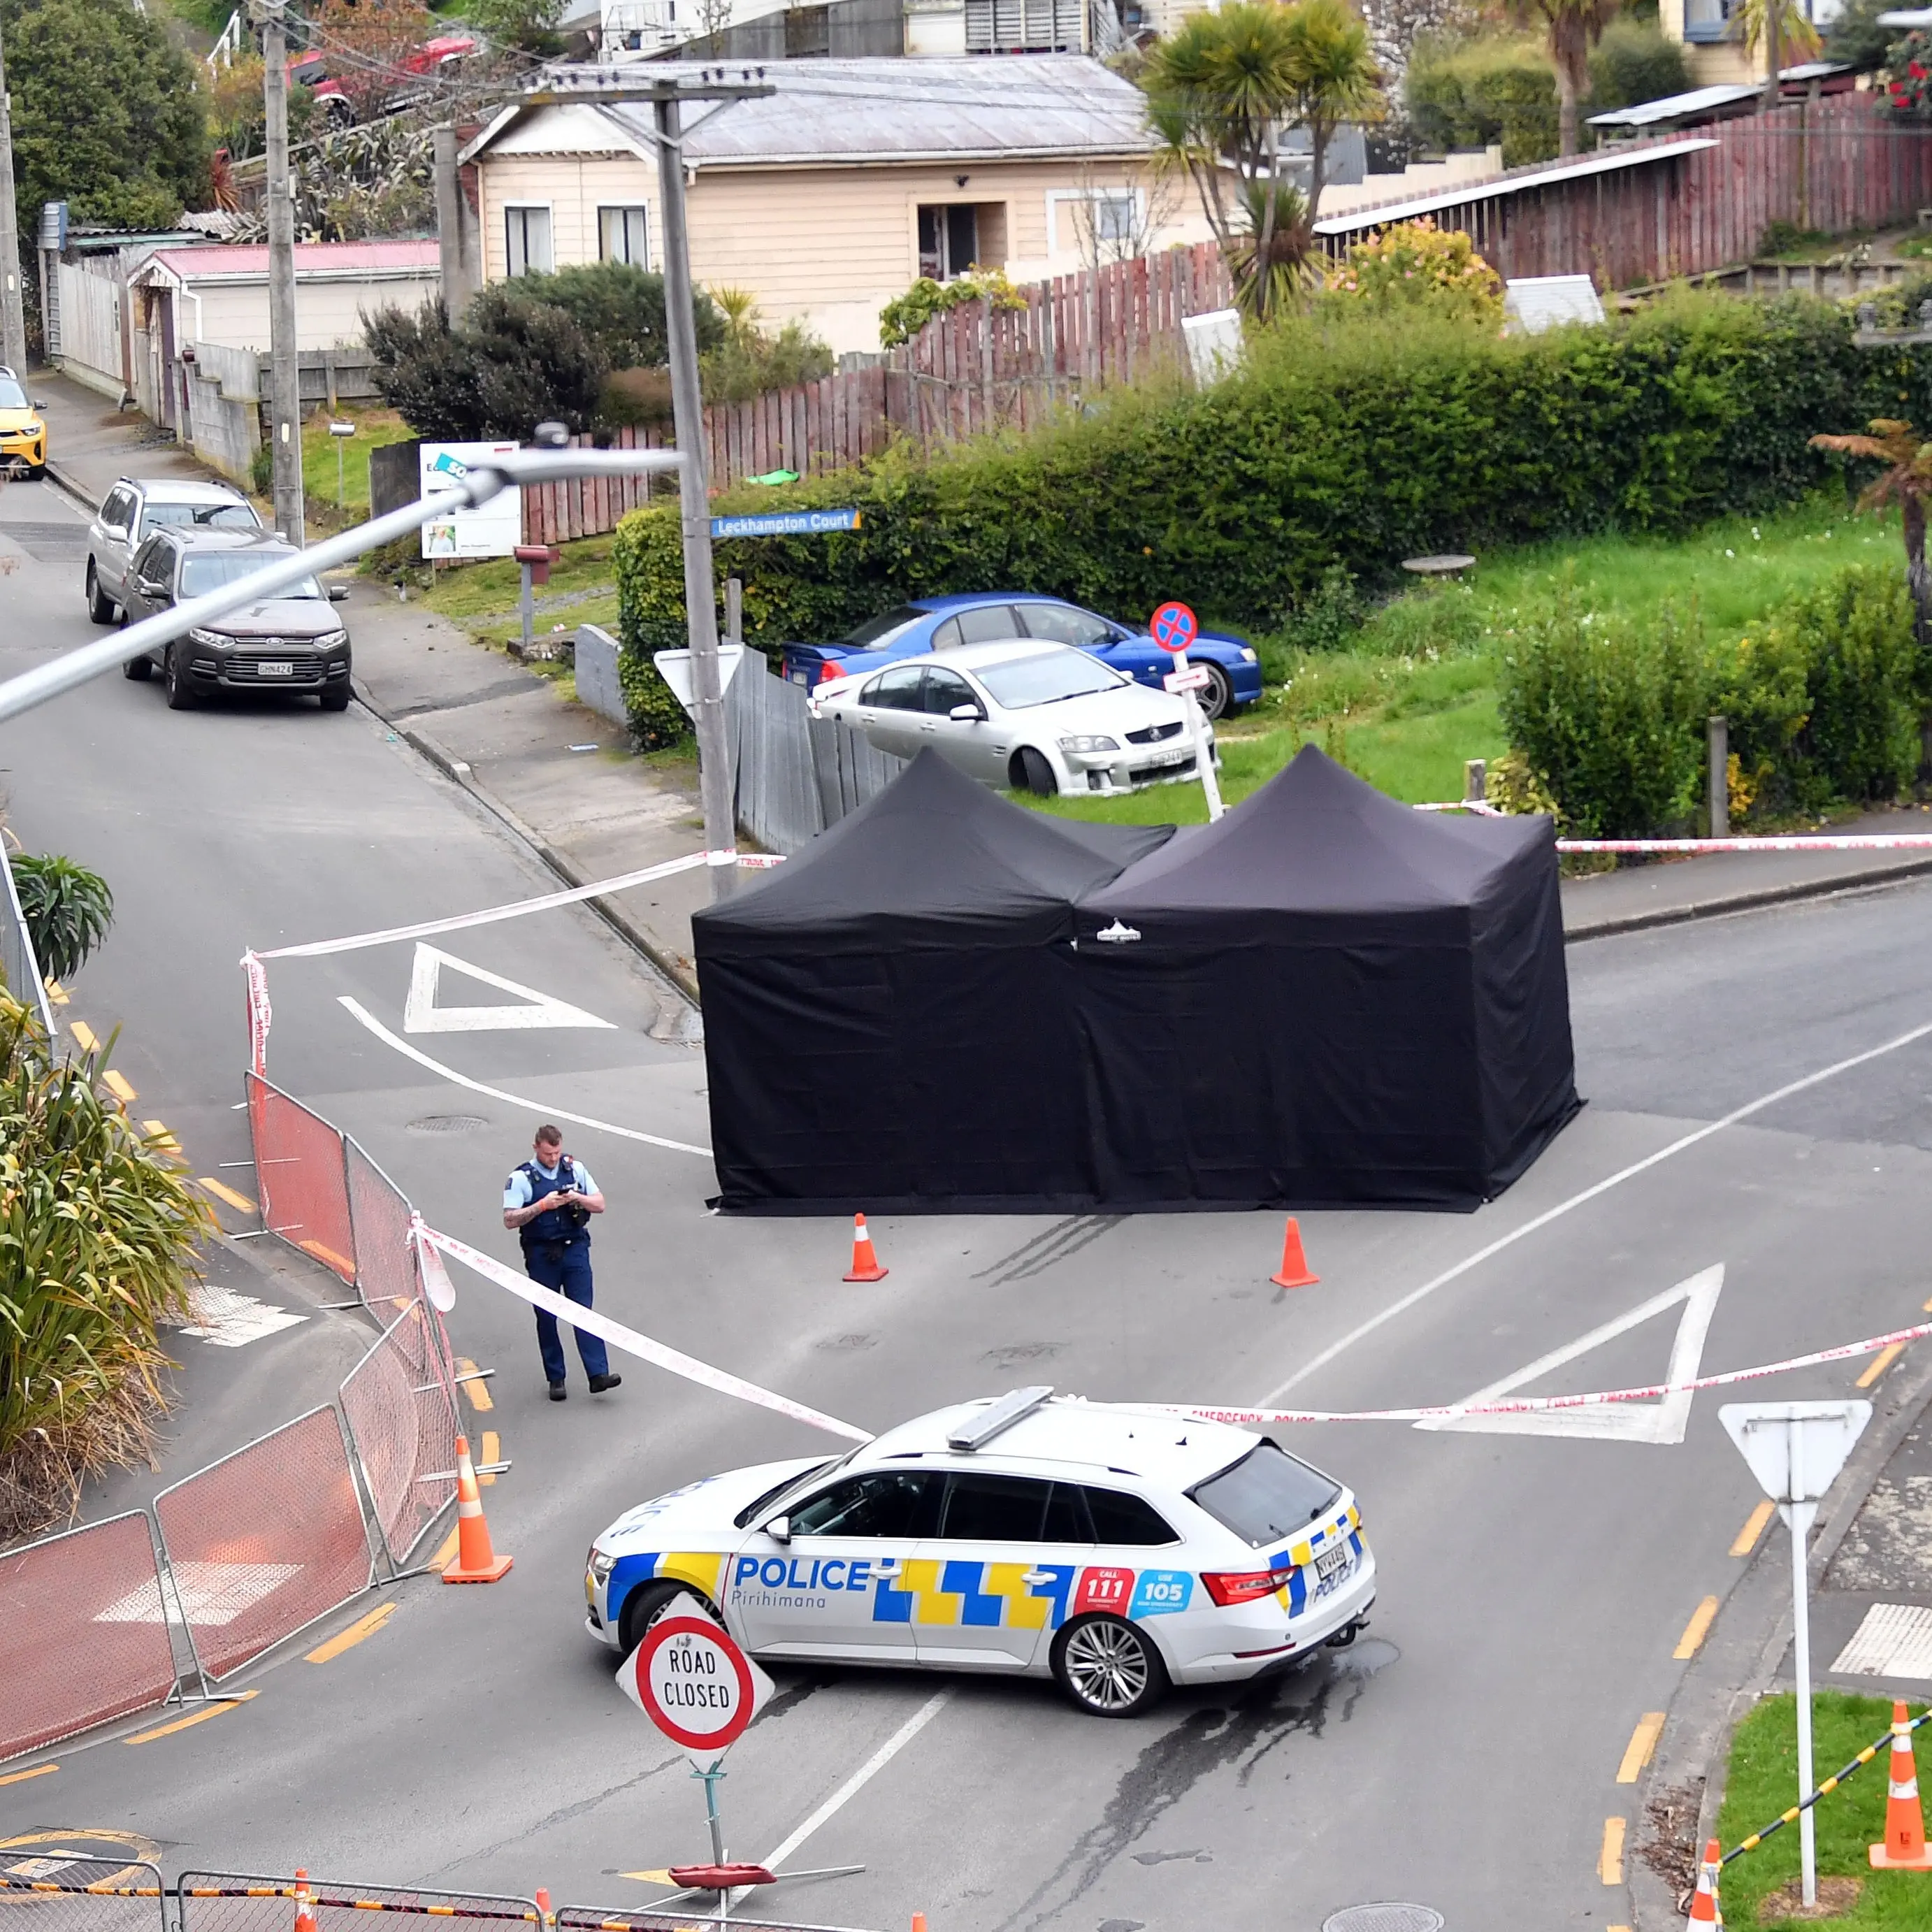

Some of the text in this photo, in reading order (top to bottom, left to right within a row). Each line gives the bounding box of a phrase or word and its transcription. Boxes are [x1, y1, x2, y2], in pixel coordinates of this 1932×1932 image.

[719, 513, 848, 533] Leckhampton Court
[735, 1557, 871, 1591] POLICE
[1088, 1579, 1124, 1597] 111
[1146, 1583, 1183, 1601] 105
[731, 1590, 826, 1608] Pirihimana
[669, 1650, 715, 1675] ROAD
[664, 1682, 730, 1708] CLOSED
